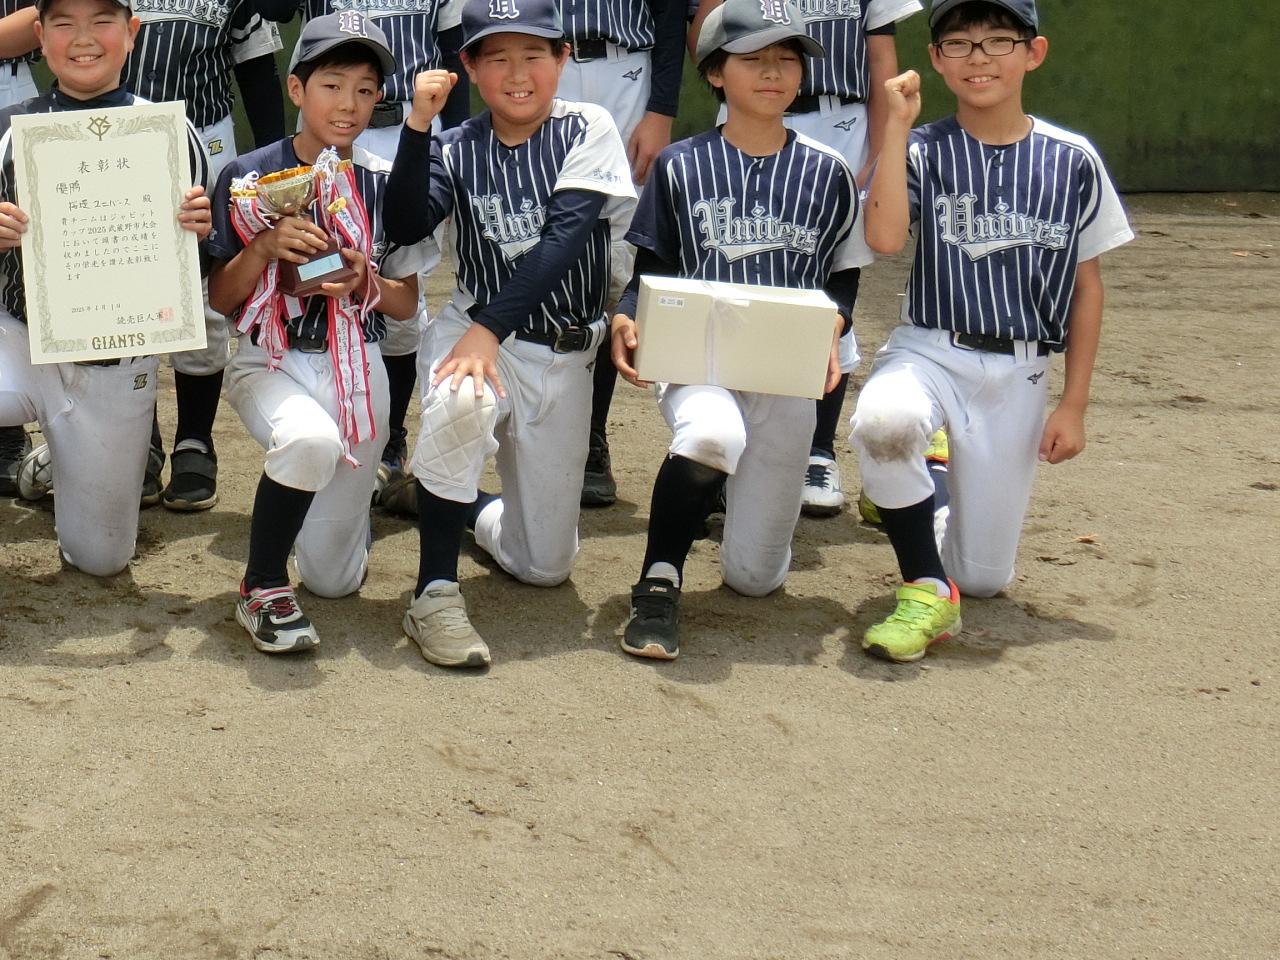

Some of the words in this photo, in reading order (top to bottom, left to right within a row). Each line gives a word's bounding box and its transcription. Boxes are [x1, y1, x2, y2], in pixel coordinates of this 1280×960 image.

[78, 157, 131, 174] 表彰状
[91, 332, 146, 351] GIANTS
